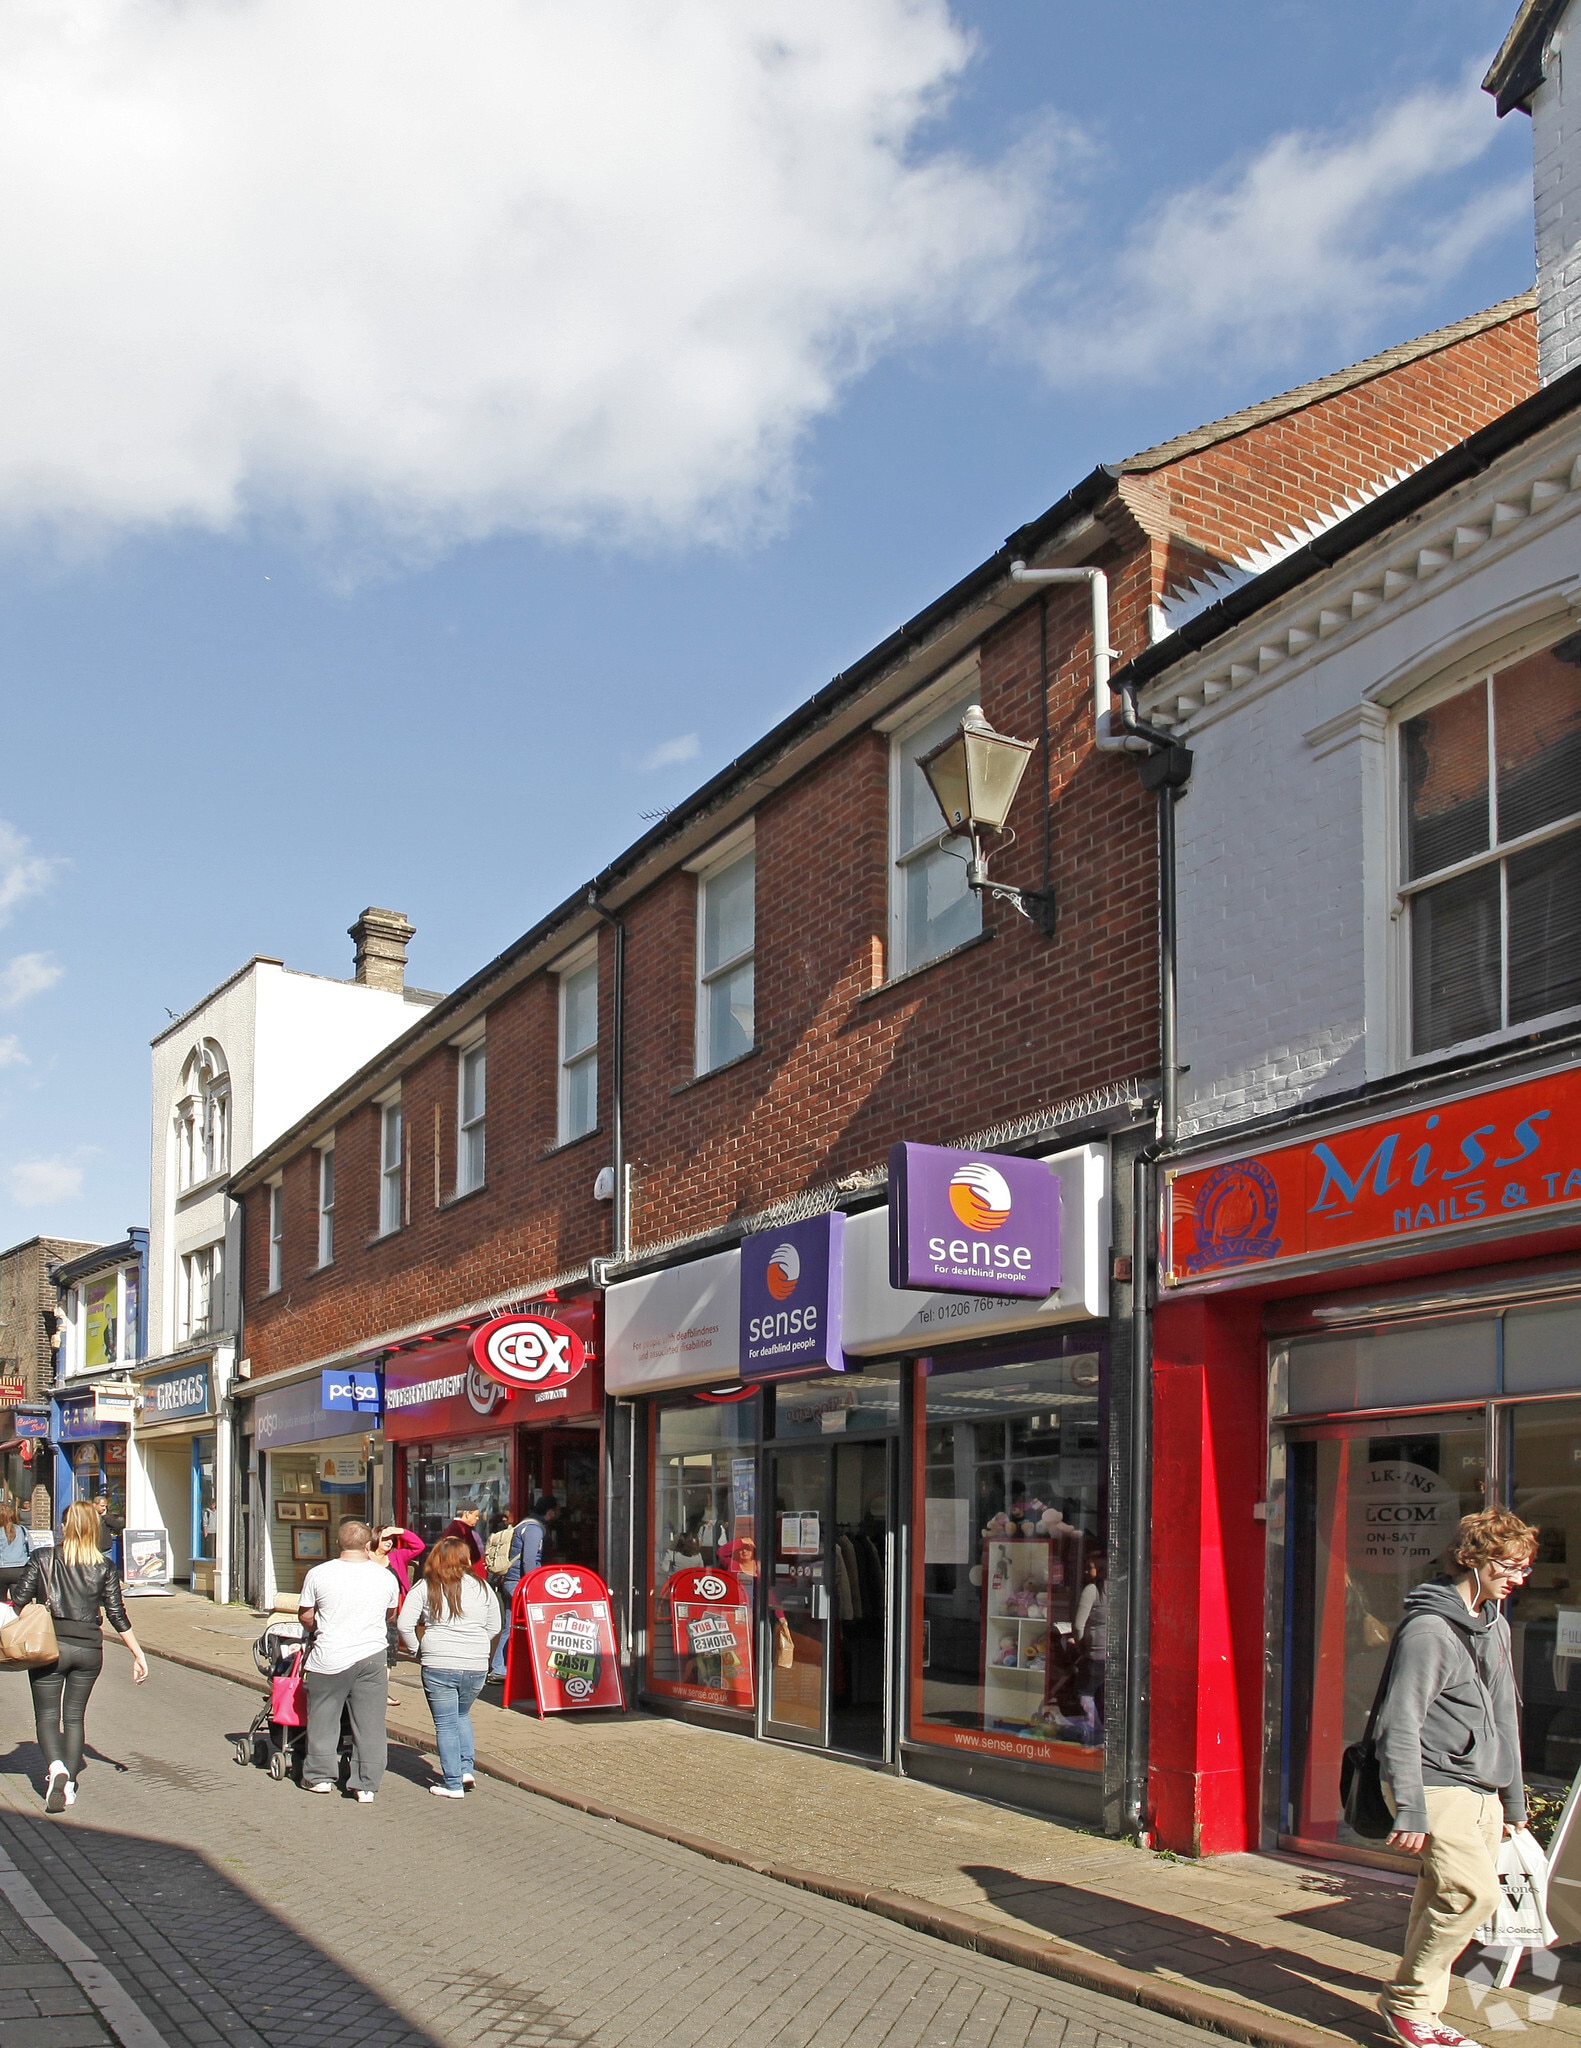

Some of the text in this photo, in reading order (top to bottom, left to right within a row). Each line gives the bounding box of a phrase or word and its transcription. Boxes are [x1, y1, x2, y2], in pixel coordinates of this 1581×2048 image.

[955, 811, 962, 823] 3
[1307, 1109, 1551, 1214] Miss
[1393, 1190, 1486, 1232] NAILS
[1501, 1182, 1529, 1208] &
[928, 1237, 1032, 1270] sense
[1193, 1240, 1273, 1266] SERVICE
[934, 1264, 1027, 1282] For deafblind people
[918, 1310, 935, 1324] Tel:
[937, 1301, 970, 1320] 01206
[974, 1298, 994, 1314] 766
[749, 1305, 817, 1342] sense
[632, 1341, 642, 1351] For
[676, 1324, 720, 1342] deafblindness
[650, 1344, 680, 1360] associated
[680, 1337, 713, 1353] disabilities
[749, 1336, 816, 1359] For deafblind people
[157, 1374, 204, 1411] GREGGS
[329, 1382, 376, 1401] pdsa
[258, 1411, 278, 1440] pdsa
[1367, 1470, 1435, 1493] LK-INS
[1382, 1547, 1395, 1556] to
[1401, 1547, 1430, 1557] 7pm
[571, 1621, 591, 1633] BUY
[550, 1635, 592, 1650] PHONES
[554, 1653, 589, 1672] CASH
[672, 1685, 728, 1702] www.sense.org.uk
[954, 1733, 1050, 1758] www.sense.org.uk
[1506, 1926, 1543, 1934] Collect
